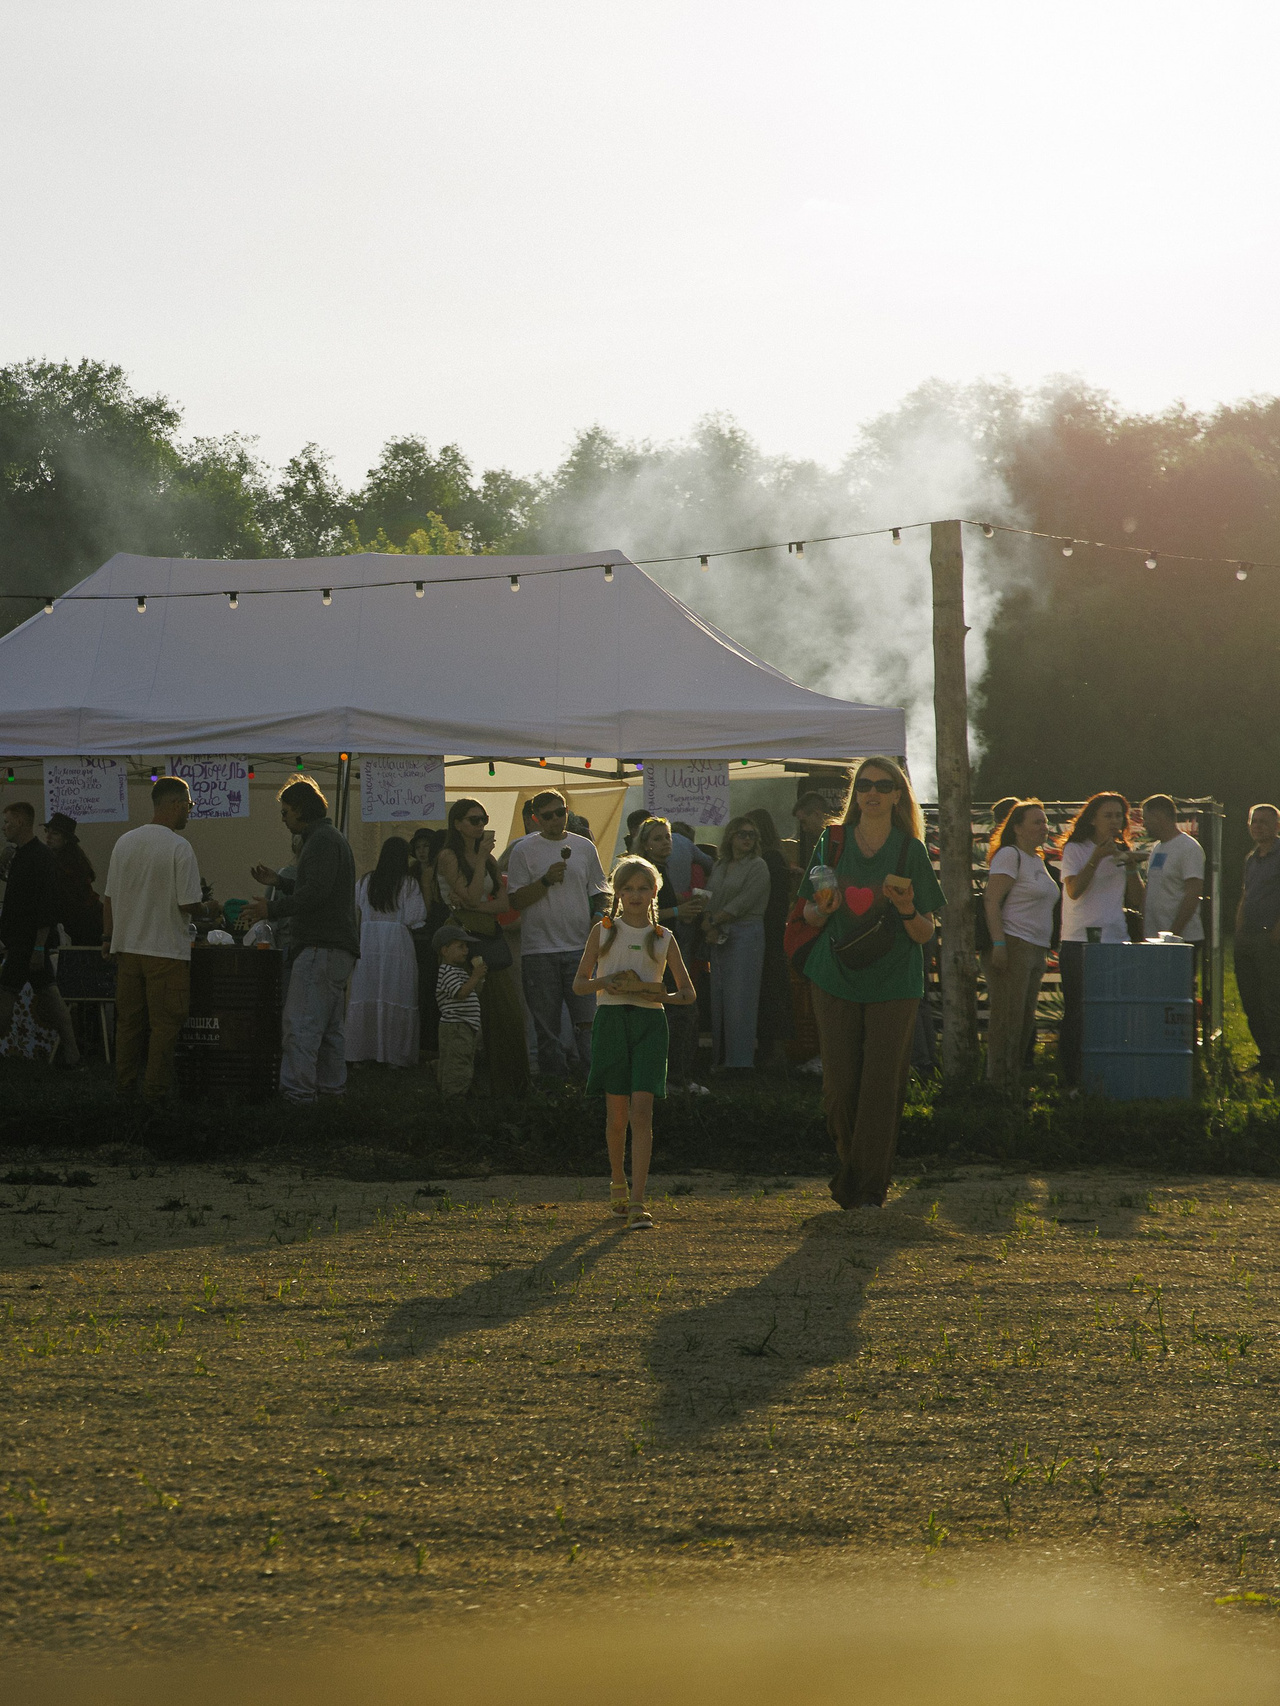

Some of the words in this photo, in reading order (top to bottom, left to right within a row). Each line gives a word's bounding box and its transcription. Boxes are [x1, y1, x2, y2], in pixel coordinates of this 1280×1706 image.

[170, 756, 247, 787] Картофель
[665, 767, 730, 795] Шаурма
[192, 781, 228, 799] фри
[646, 762, 663, 815] рмошка
